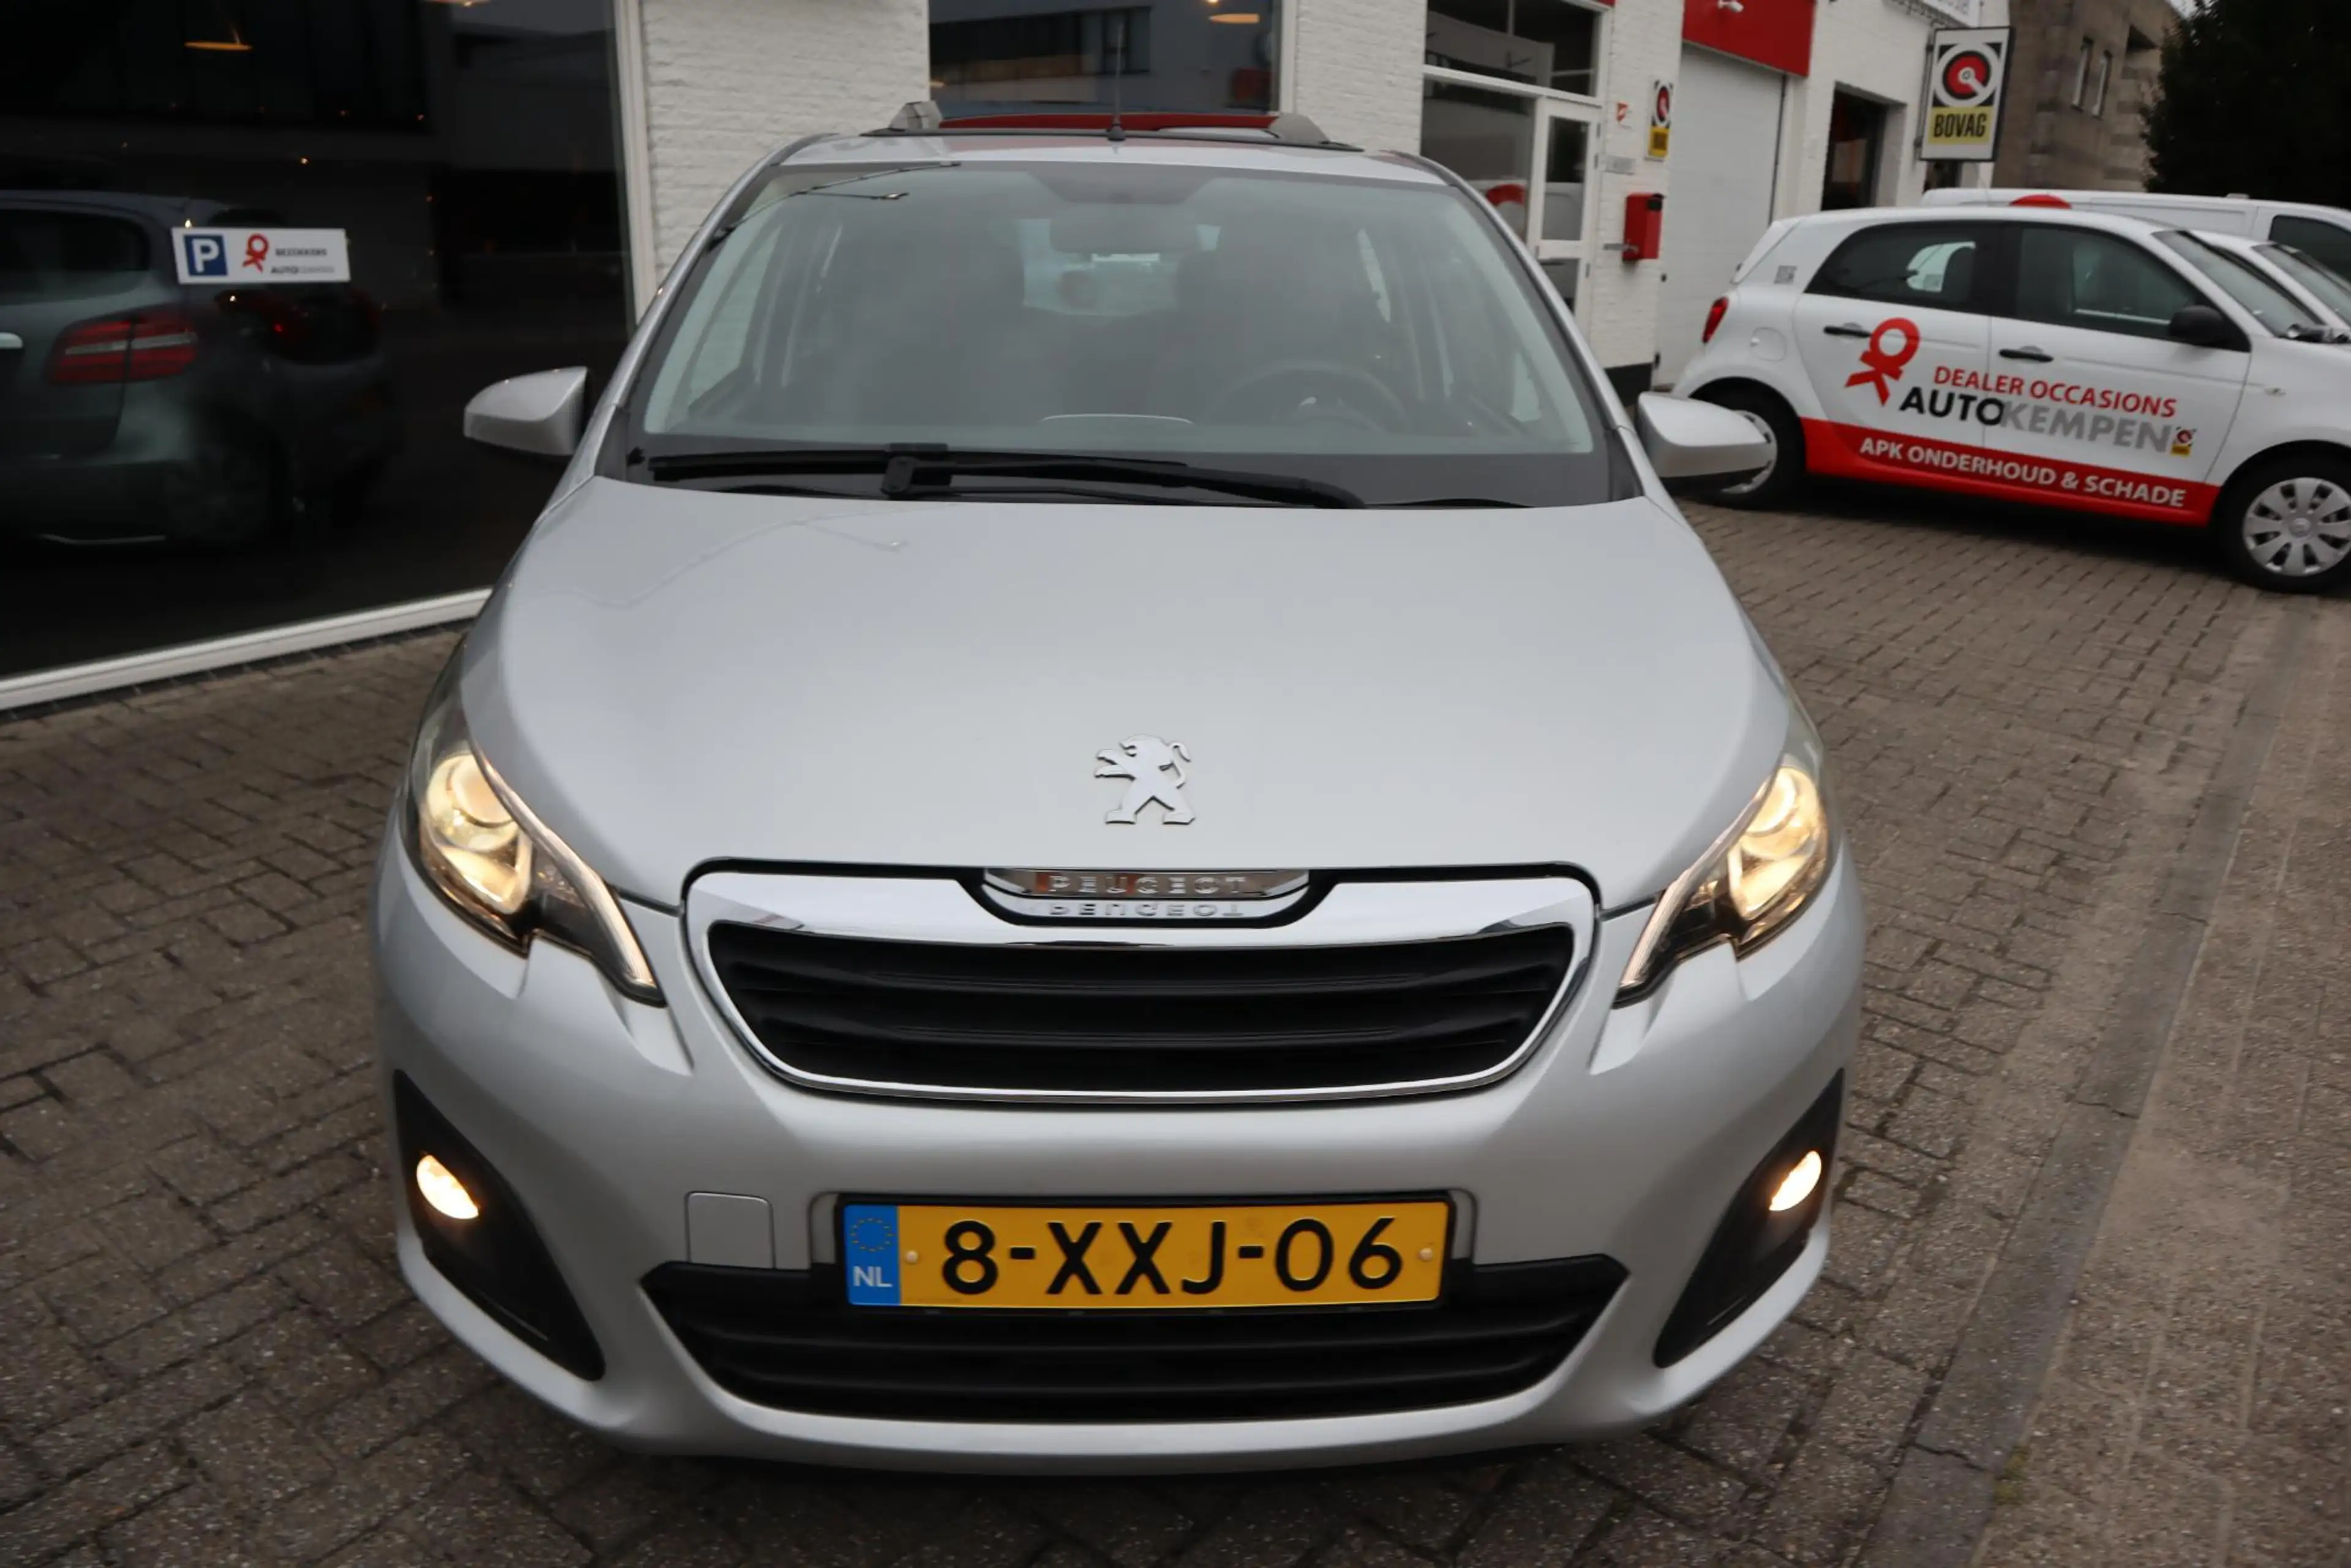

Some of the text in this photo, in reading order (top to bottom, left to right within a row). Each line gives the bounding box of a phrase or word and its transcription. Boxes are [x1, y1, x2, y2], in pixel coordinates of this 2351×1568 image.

[1933, 113, 1987, 138] BOVAG
[192, 238, 219, 273] P
[1934, 366, 2177, 418] DEALER OCCASIONS
[1859, 437, 2186, 507] APK ONDERHOUD & SCHADE
[1048, 875, 1247, 894] PEUGEOT
[941, 1216, 1404, 1295] 8-XXJ-06
[853, 1266, 893, 1287] NL
